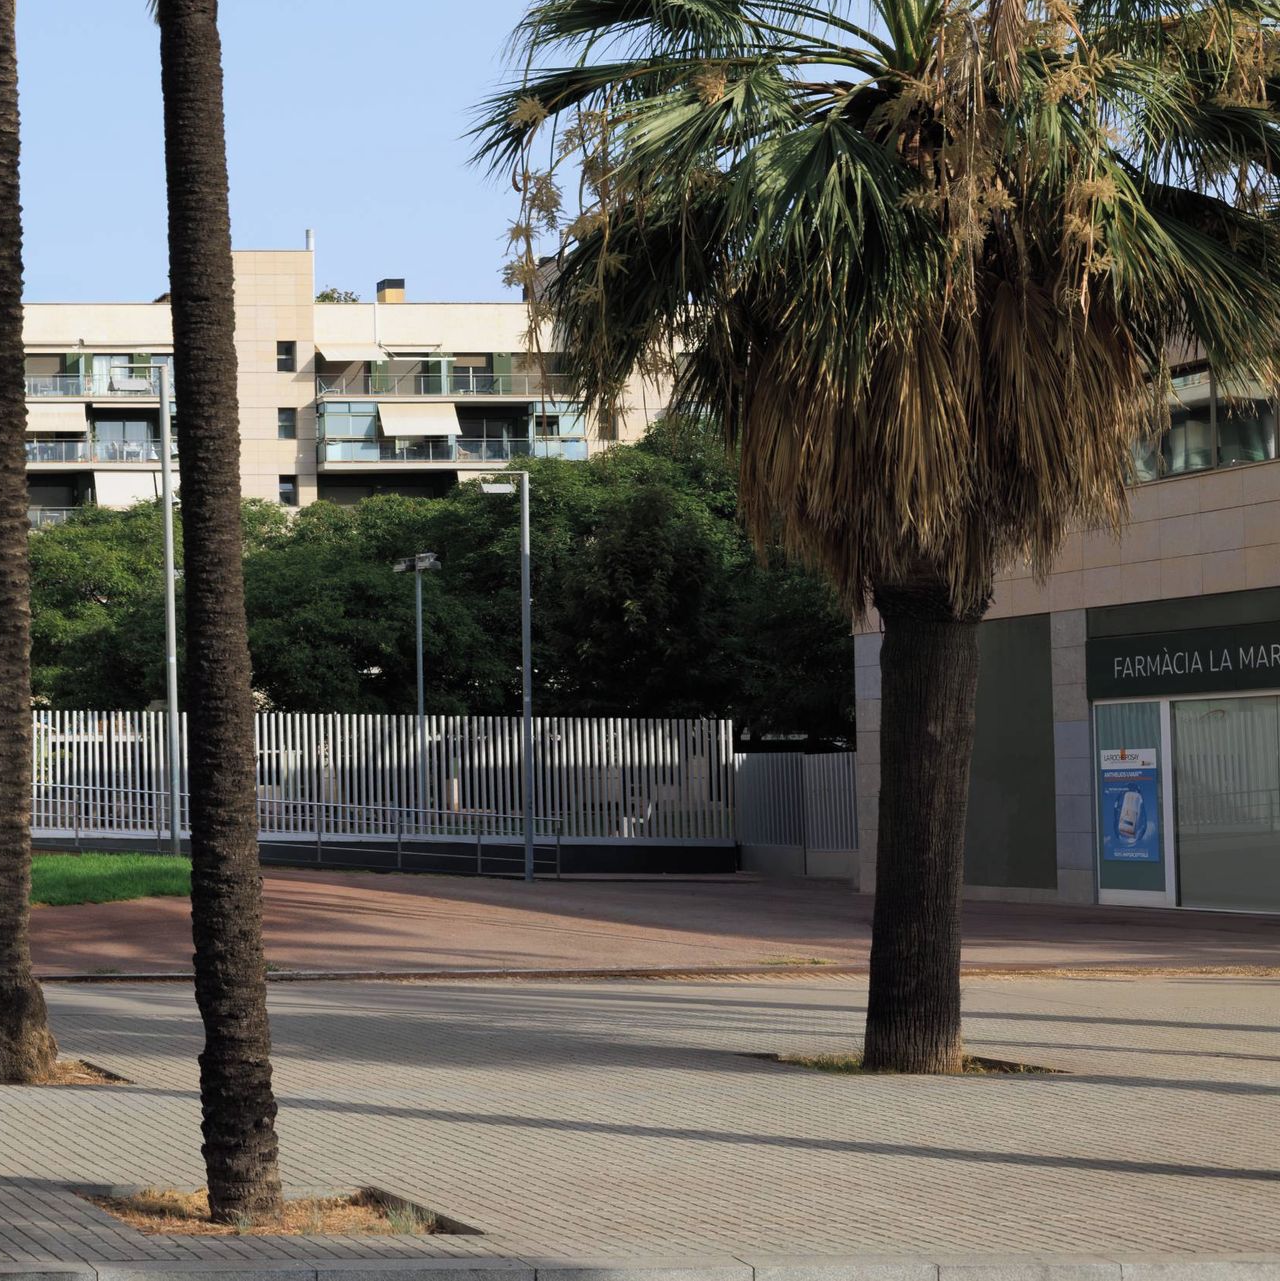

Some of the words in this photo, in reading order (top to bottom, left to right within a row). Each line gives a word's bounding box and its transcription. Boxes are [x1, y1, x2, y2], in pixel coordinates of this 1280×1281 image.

[1114, 647, 1203, 679] FARMÀCIA
[1209, 648, 1233, 672] LA
[1239, 643, 1280, 670] MAR
